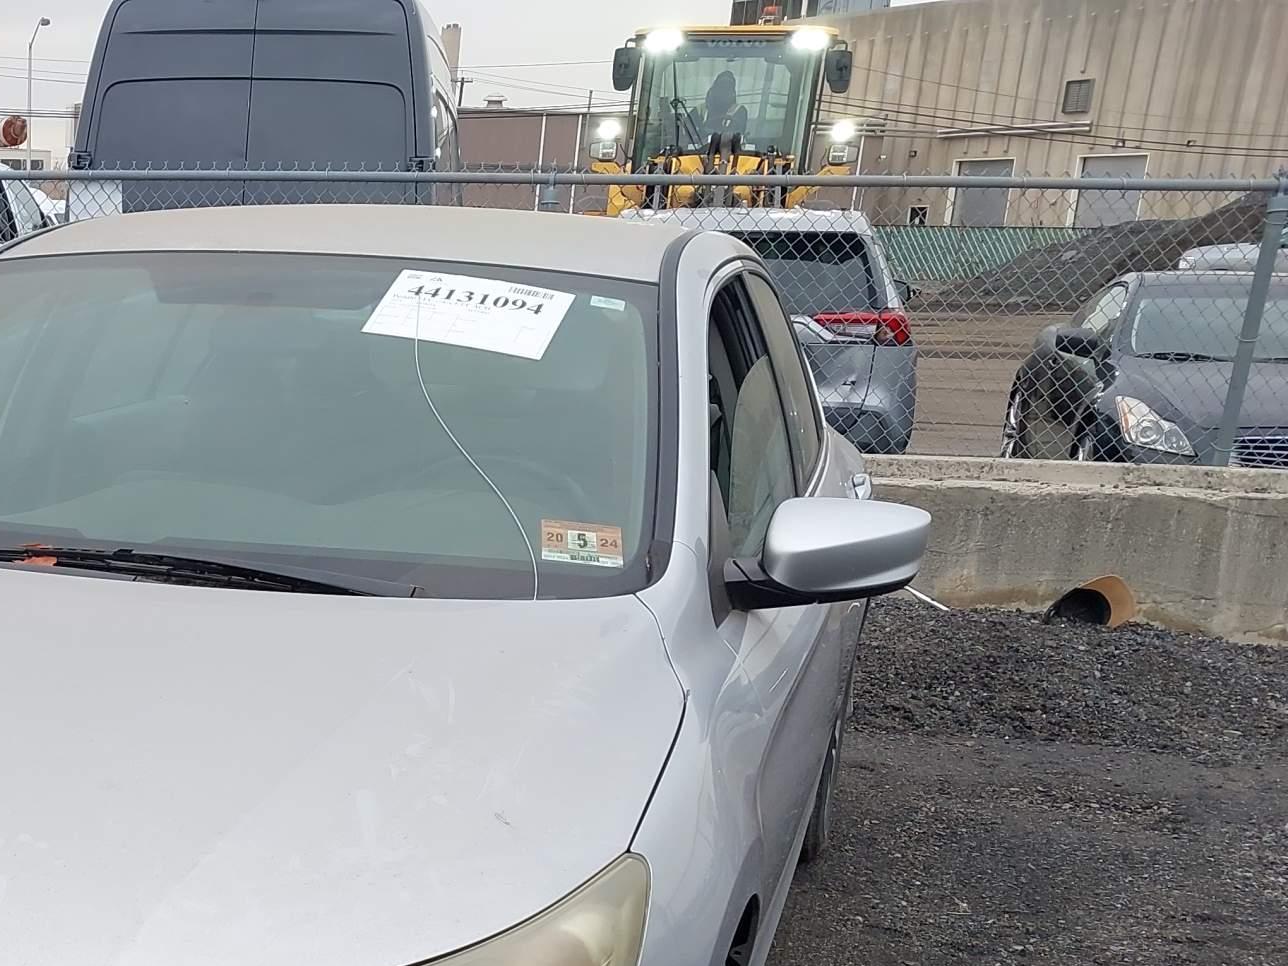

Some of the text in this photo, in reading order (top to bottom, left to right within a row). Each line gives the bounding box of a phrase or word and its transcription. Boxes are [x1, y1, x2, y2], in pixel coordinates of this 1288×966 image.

[708, 39, 767, 48] VOLVO
[407, 284, 545, 316] 44131094
[546, 531, 618, 549] 20 5 24
